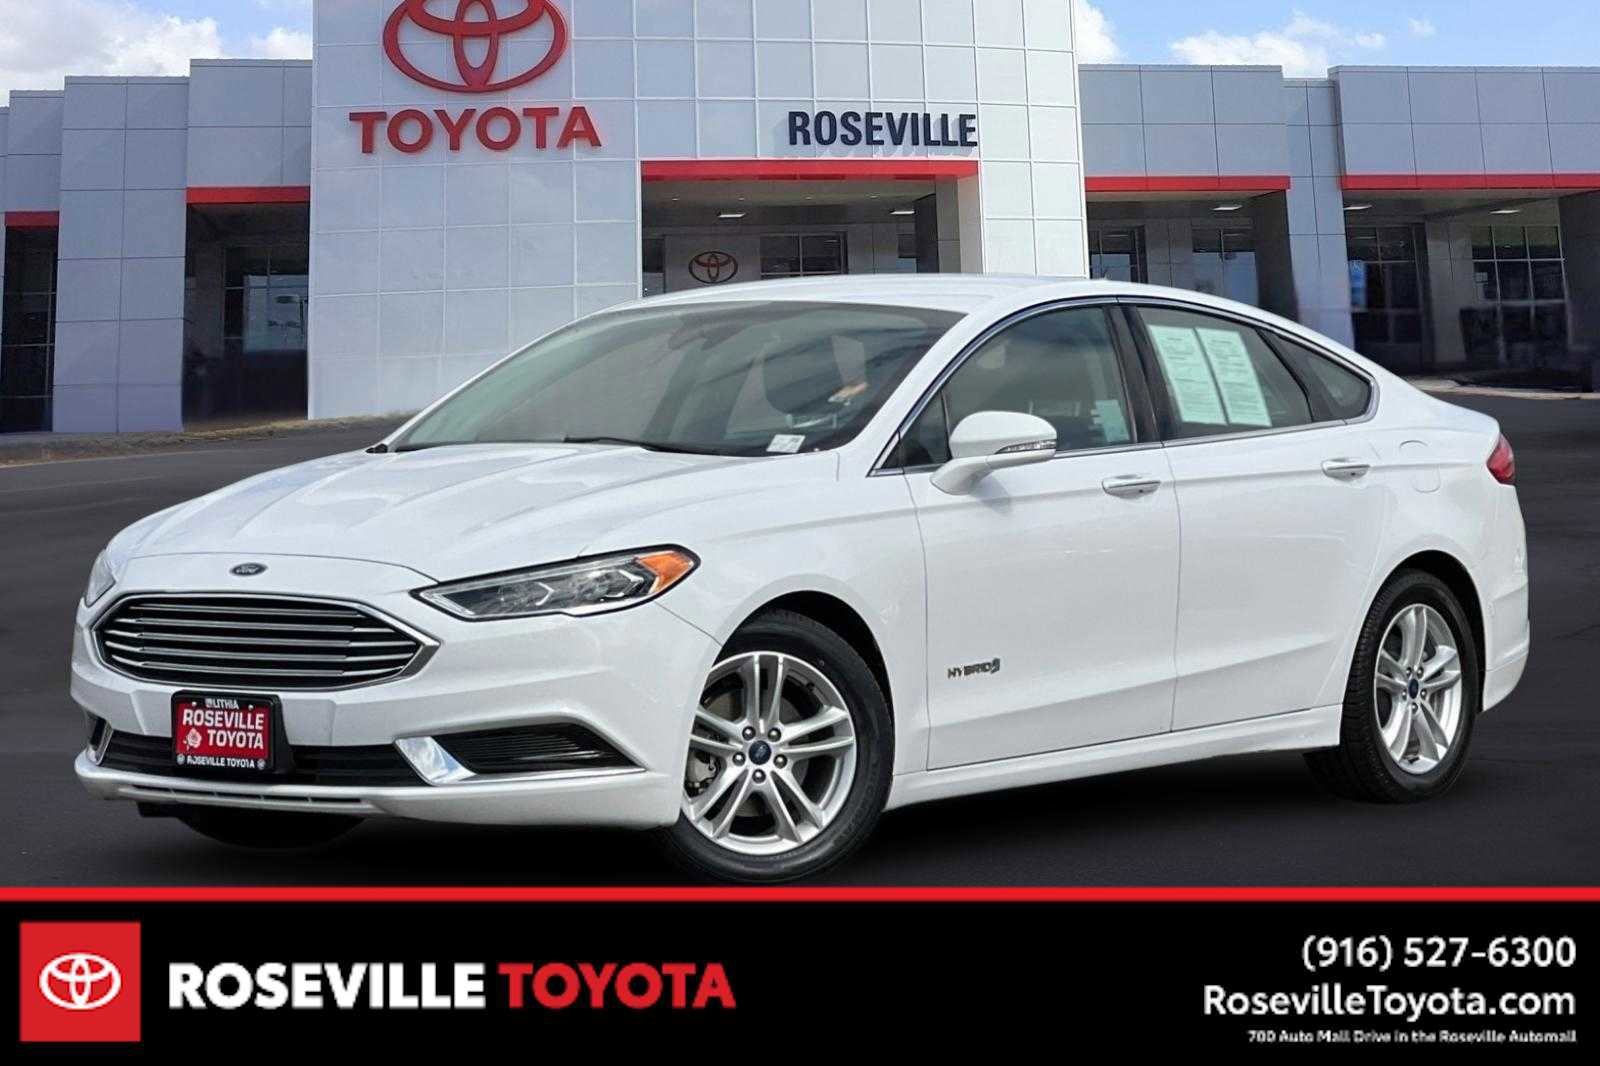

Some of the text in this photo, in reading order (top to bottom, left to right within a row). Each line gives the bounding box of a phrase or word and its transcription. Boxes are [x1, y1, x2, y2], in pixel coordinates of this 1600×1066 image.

[349, 106, 602, 154] TOYOTA
[788, 110, 978, 147] ROSEVILLE
[947, 661, 992, 679] HYBRID
[213, 698, 239, 710] LITHIA
[182, 708, 265, 731] ROSEVILLE
[207, 729, 264, 750] TOYOTA
[186, 755, 255, 769] ROSEVILLE TOYOTA
